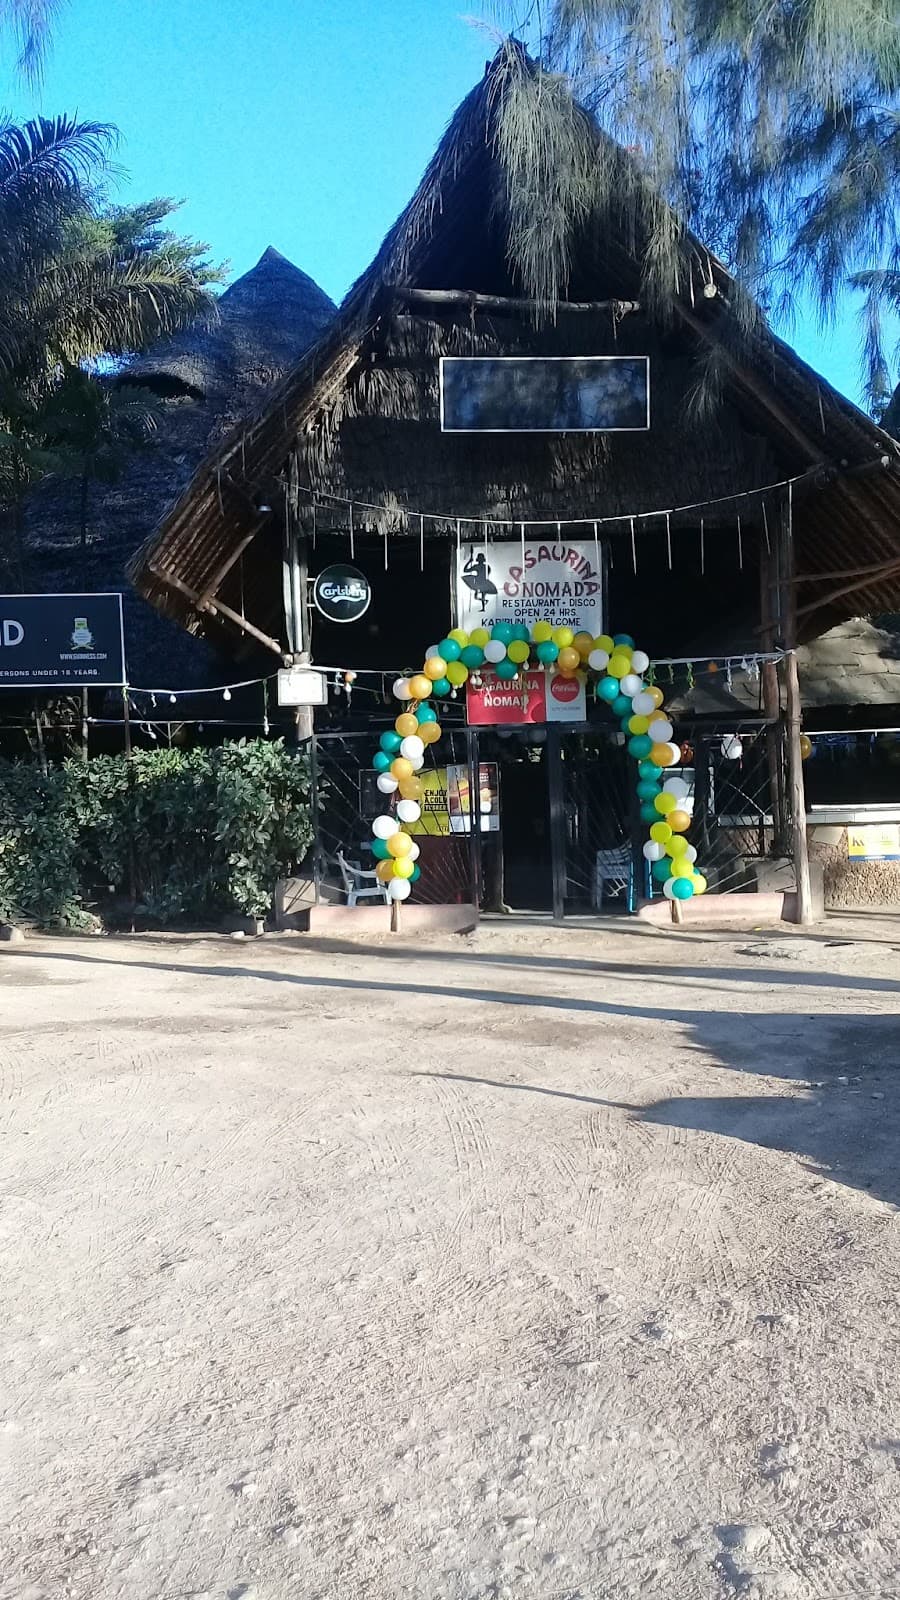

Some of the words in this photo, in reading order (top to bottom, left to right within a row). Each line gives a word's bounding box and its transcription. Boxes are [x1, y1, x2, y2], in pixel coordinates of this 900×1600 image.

[504, 545, 600, 597] CASAURINA
[319, 582, 367, 603] Carlsberg
[522, 582, 584, 597] NOMAD
[502, 599, 561, 608] RESTAURANT
[569, 599, 596, 607] DISCO
[514, 608, 540, 617] OPEN
[543, 608, 556, 617] 24
[0, 620, 25, 646] D
